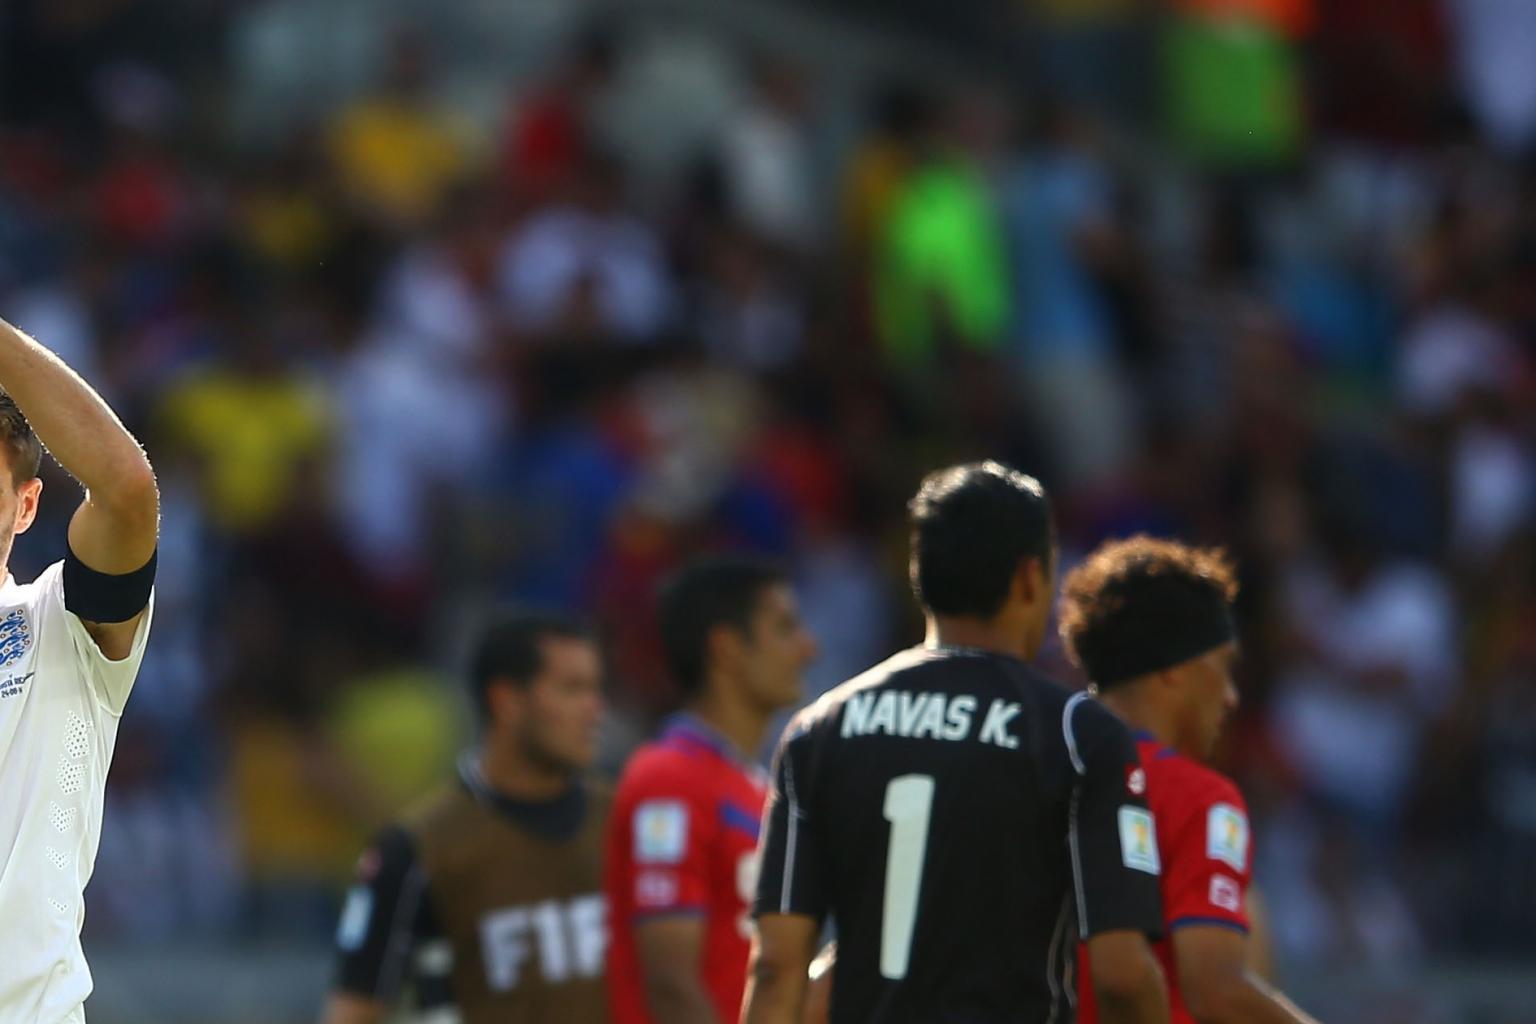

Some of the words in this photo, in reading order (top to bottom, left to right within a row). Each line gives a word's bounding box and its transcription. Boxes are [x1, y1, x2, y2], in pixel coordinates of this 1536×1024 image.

[840, 689, 977, 742] NAVAS
[979, 697, 1023, 750] K.
[880, 773, 936, 980] 1
[478, 893, 609, 991] FIF
